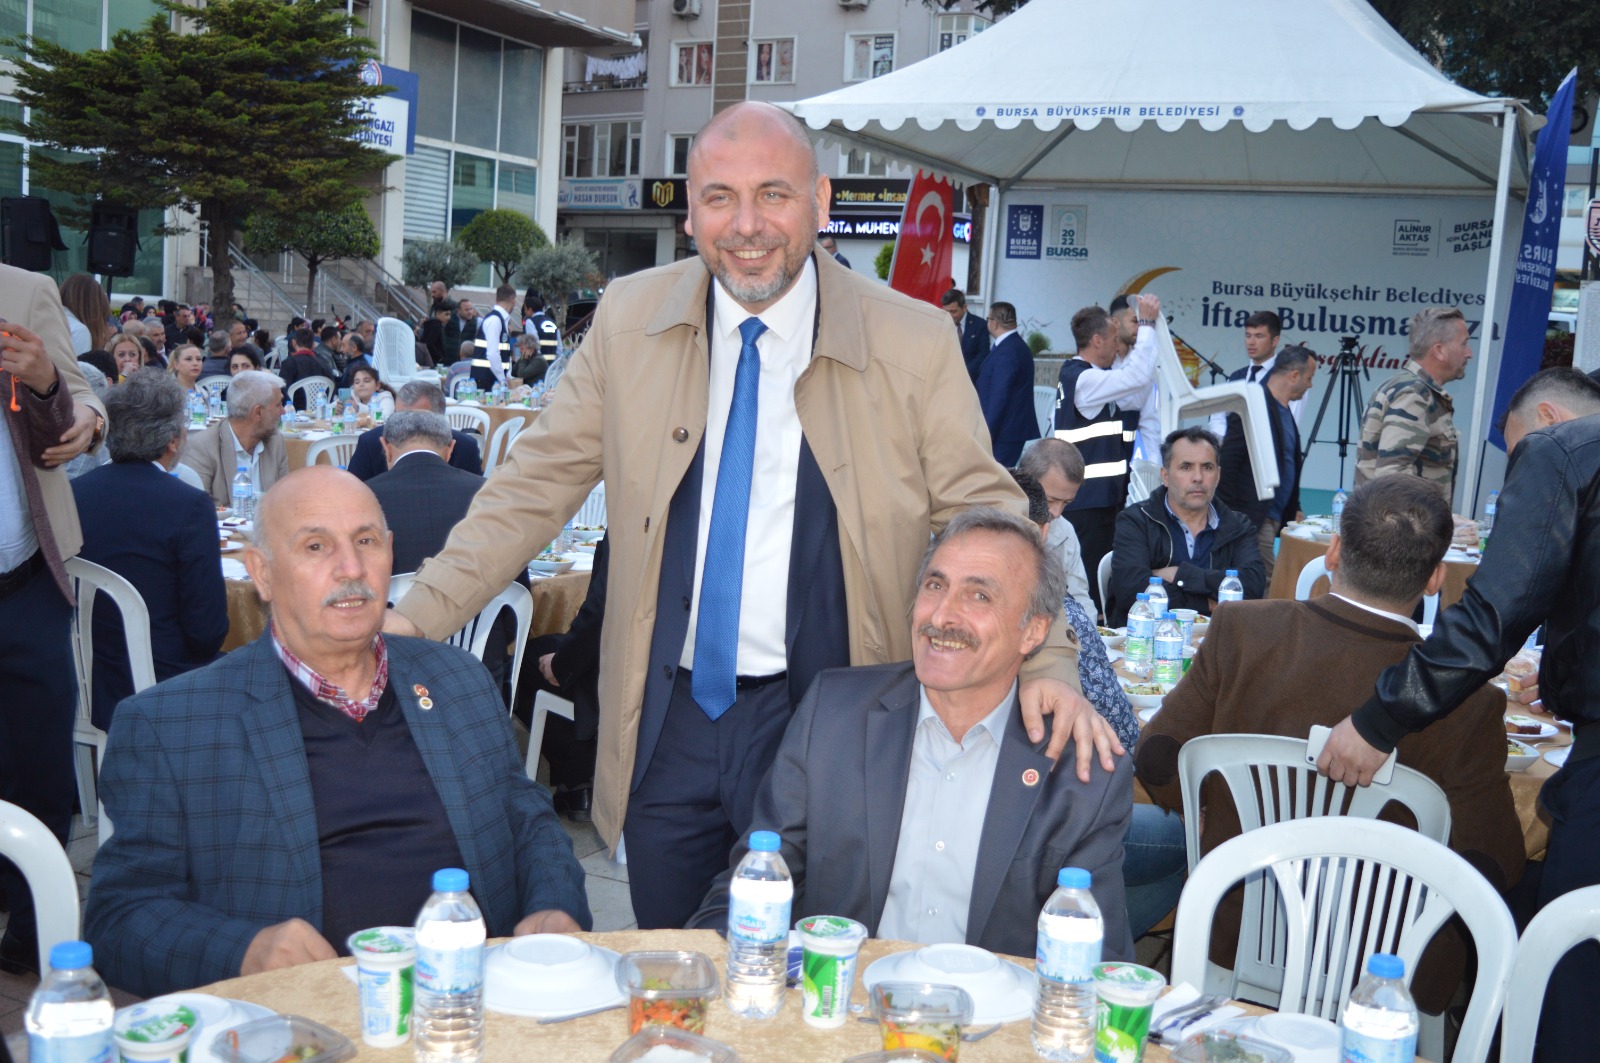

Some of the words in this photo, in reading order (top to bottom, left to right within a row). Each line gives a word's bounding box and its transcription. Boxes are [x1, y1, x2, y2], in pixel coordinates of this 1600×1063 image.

[996, 108, 1039, 117] BURSA
[1047, 105, 1131, 118] BÜYÜKŞEHİR
[1139, 105, 1220, 116] BELEDİYESİ
[1061, 229, 1075, 237] 20
[1399, 233, 1430, 243] AKTAŞ
[1009, 238, 1038, 246] BURSA
[1061, 238, 1075, 246] 22
[1046, 246, 1089, 258] BURSA
[1211, 280, 1265, 297] Bursa
[1270, 283, 1381, 303] Büyükşehir
[1386, 287, 1485, 307] Belediyes
[1201, 296, 1258, 328] İfta
